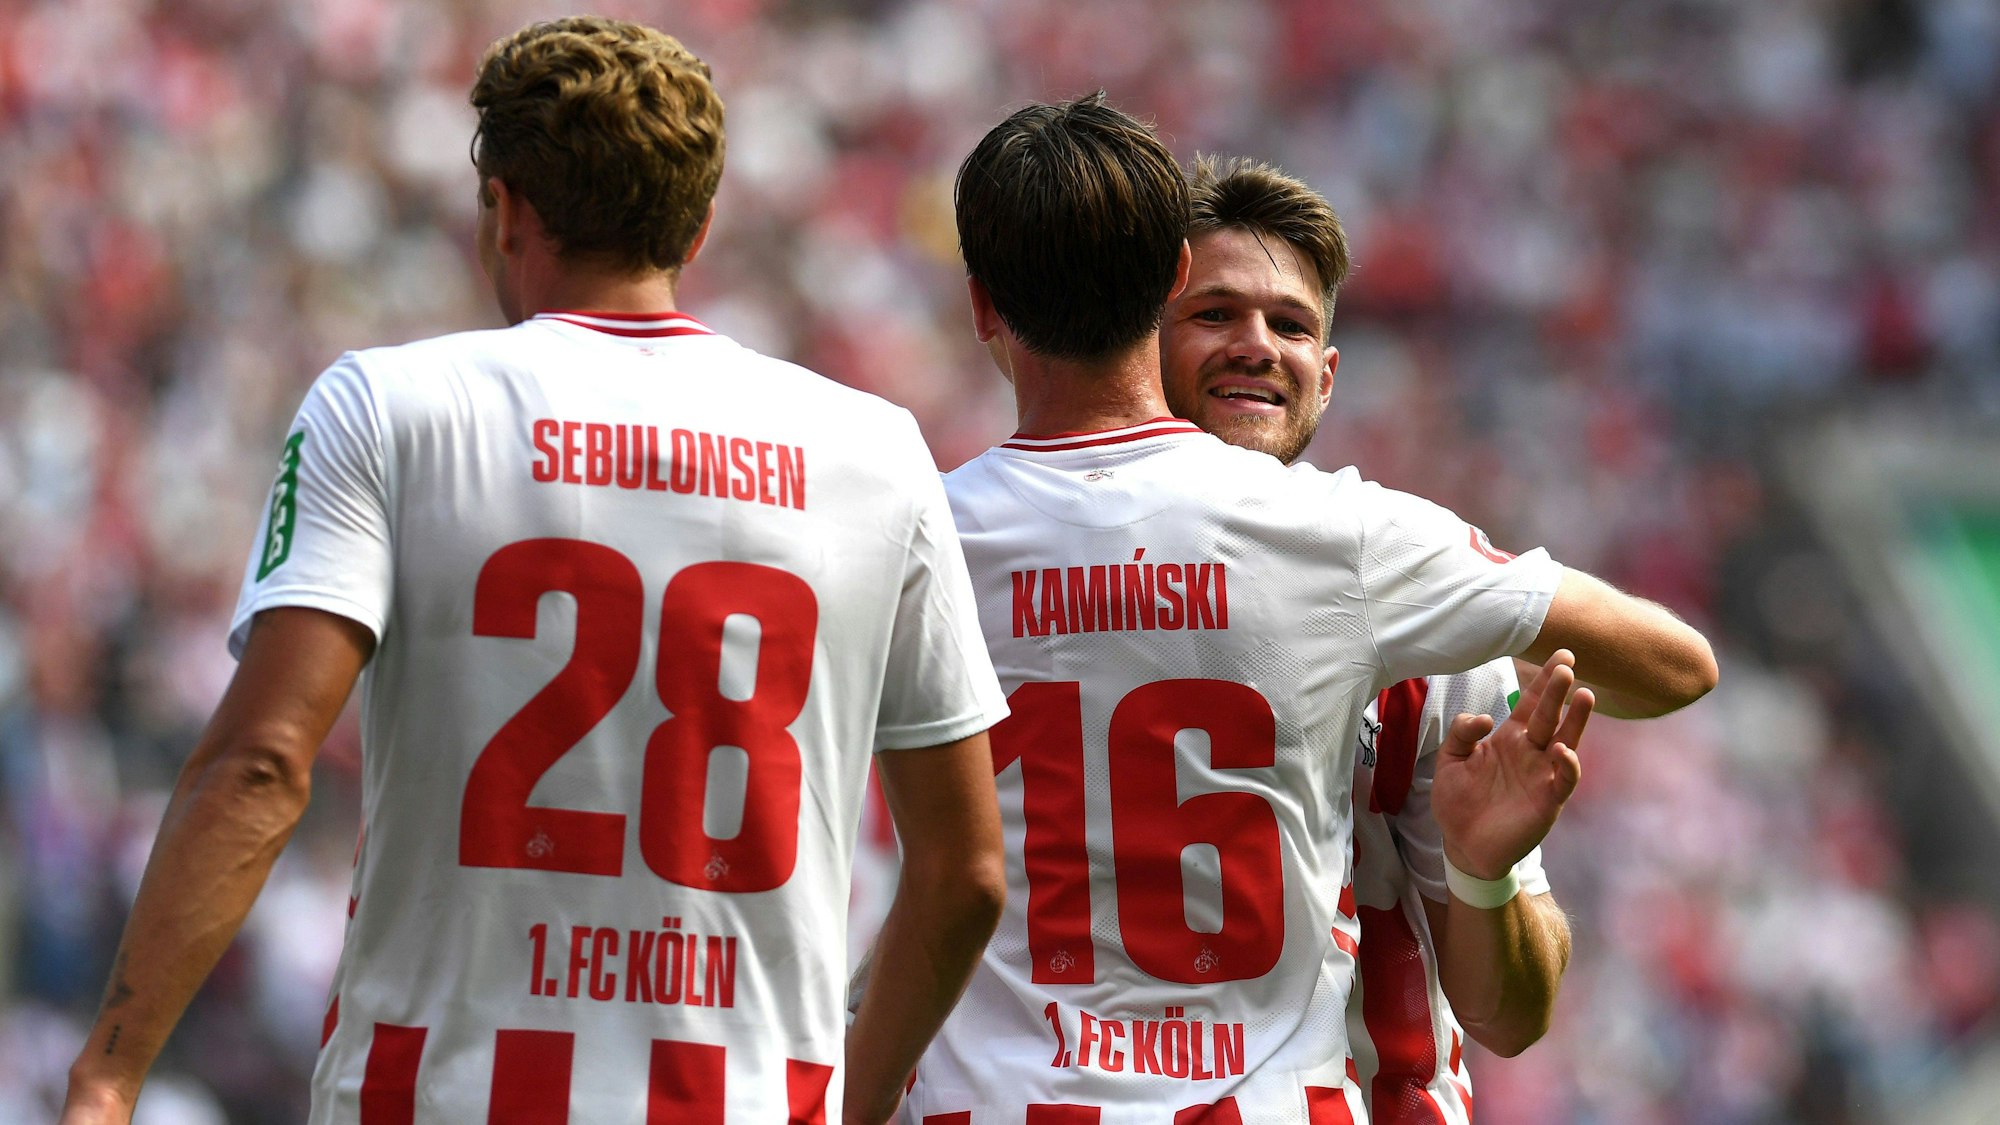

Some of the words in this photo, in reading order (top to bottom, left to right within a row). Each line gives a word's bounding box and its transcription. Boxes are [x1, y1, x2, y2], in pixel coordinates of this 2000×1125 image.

[532, 418, 806, 511] SEBULONSEN
[1011, 547, 1229, 638] KAMIŃSKI
[458, 537, 819, 894] 28
[988, 678, 1285, 985] 16
[528, 923, 558, 997] 1.
[567, 926, 619, 1001] FC
[625, 916, 737, 1008] KÖLN
[1044, 1001, 1071, 1068] 1.
[1077, 1010, 1126, 1073] FC
[1132, 1006, 1245, 1081] KÖLN
